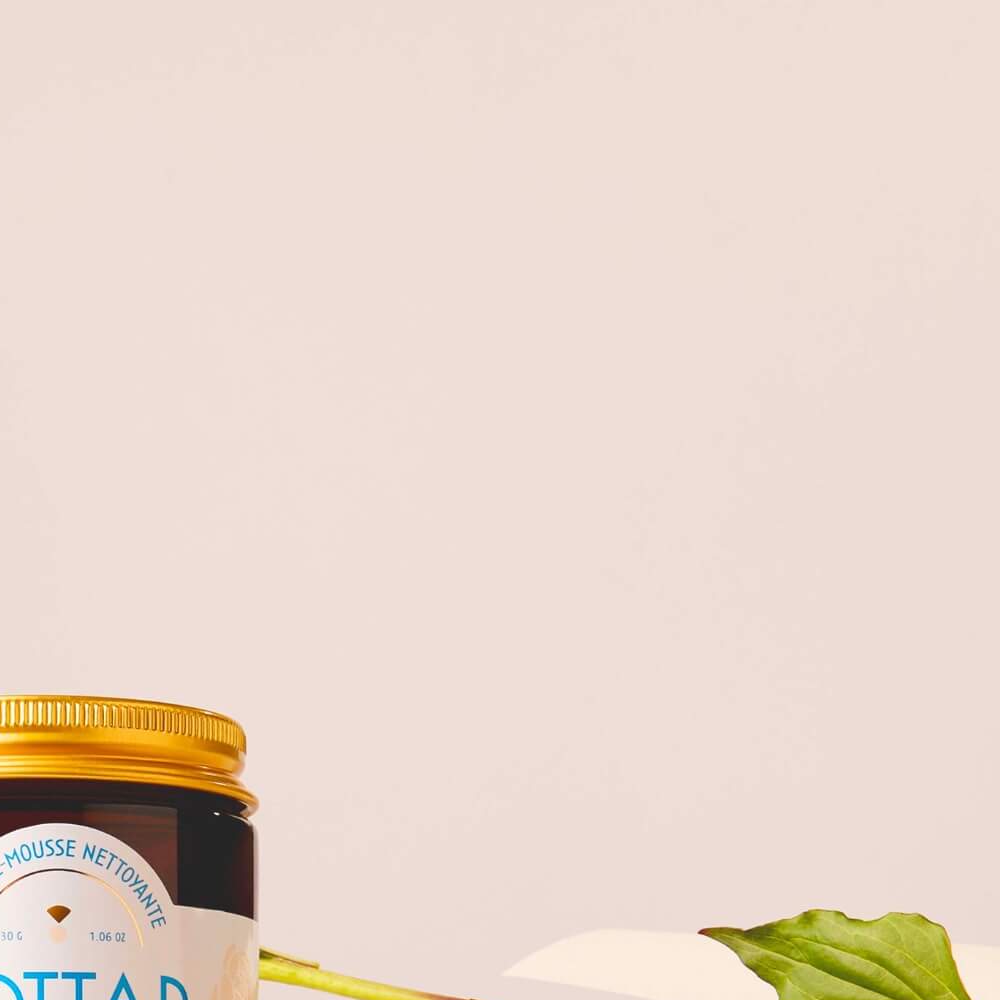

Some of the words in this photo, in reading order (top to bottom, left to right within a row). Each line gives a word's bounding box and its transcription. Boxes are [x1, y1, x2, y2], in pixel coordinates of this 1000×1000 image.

[82, 841, 168, 929] NETTOYANTE
[0, 931, 14, 942] 30
[16, 930, 23, 942] G
[89, 931, 112, 942] 1.06
